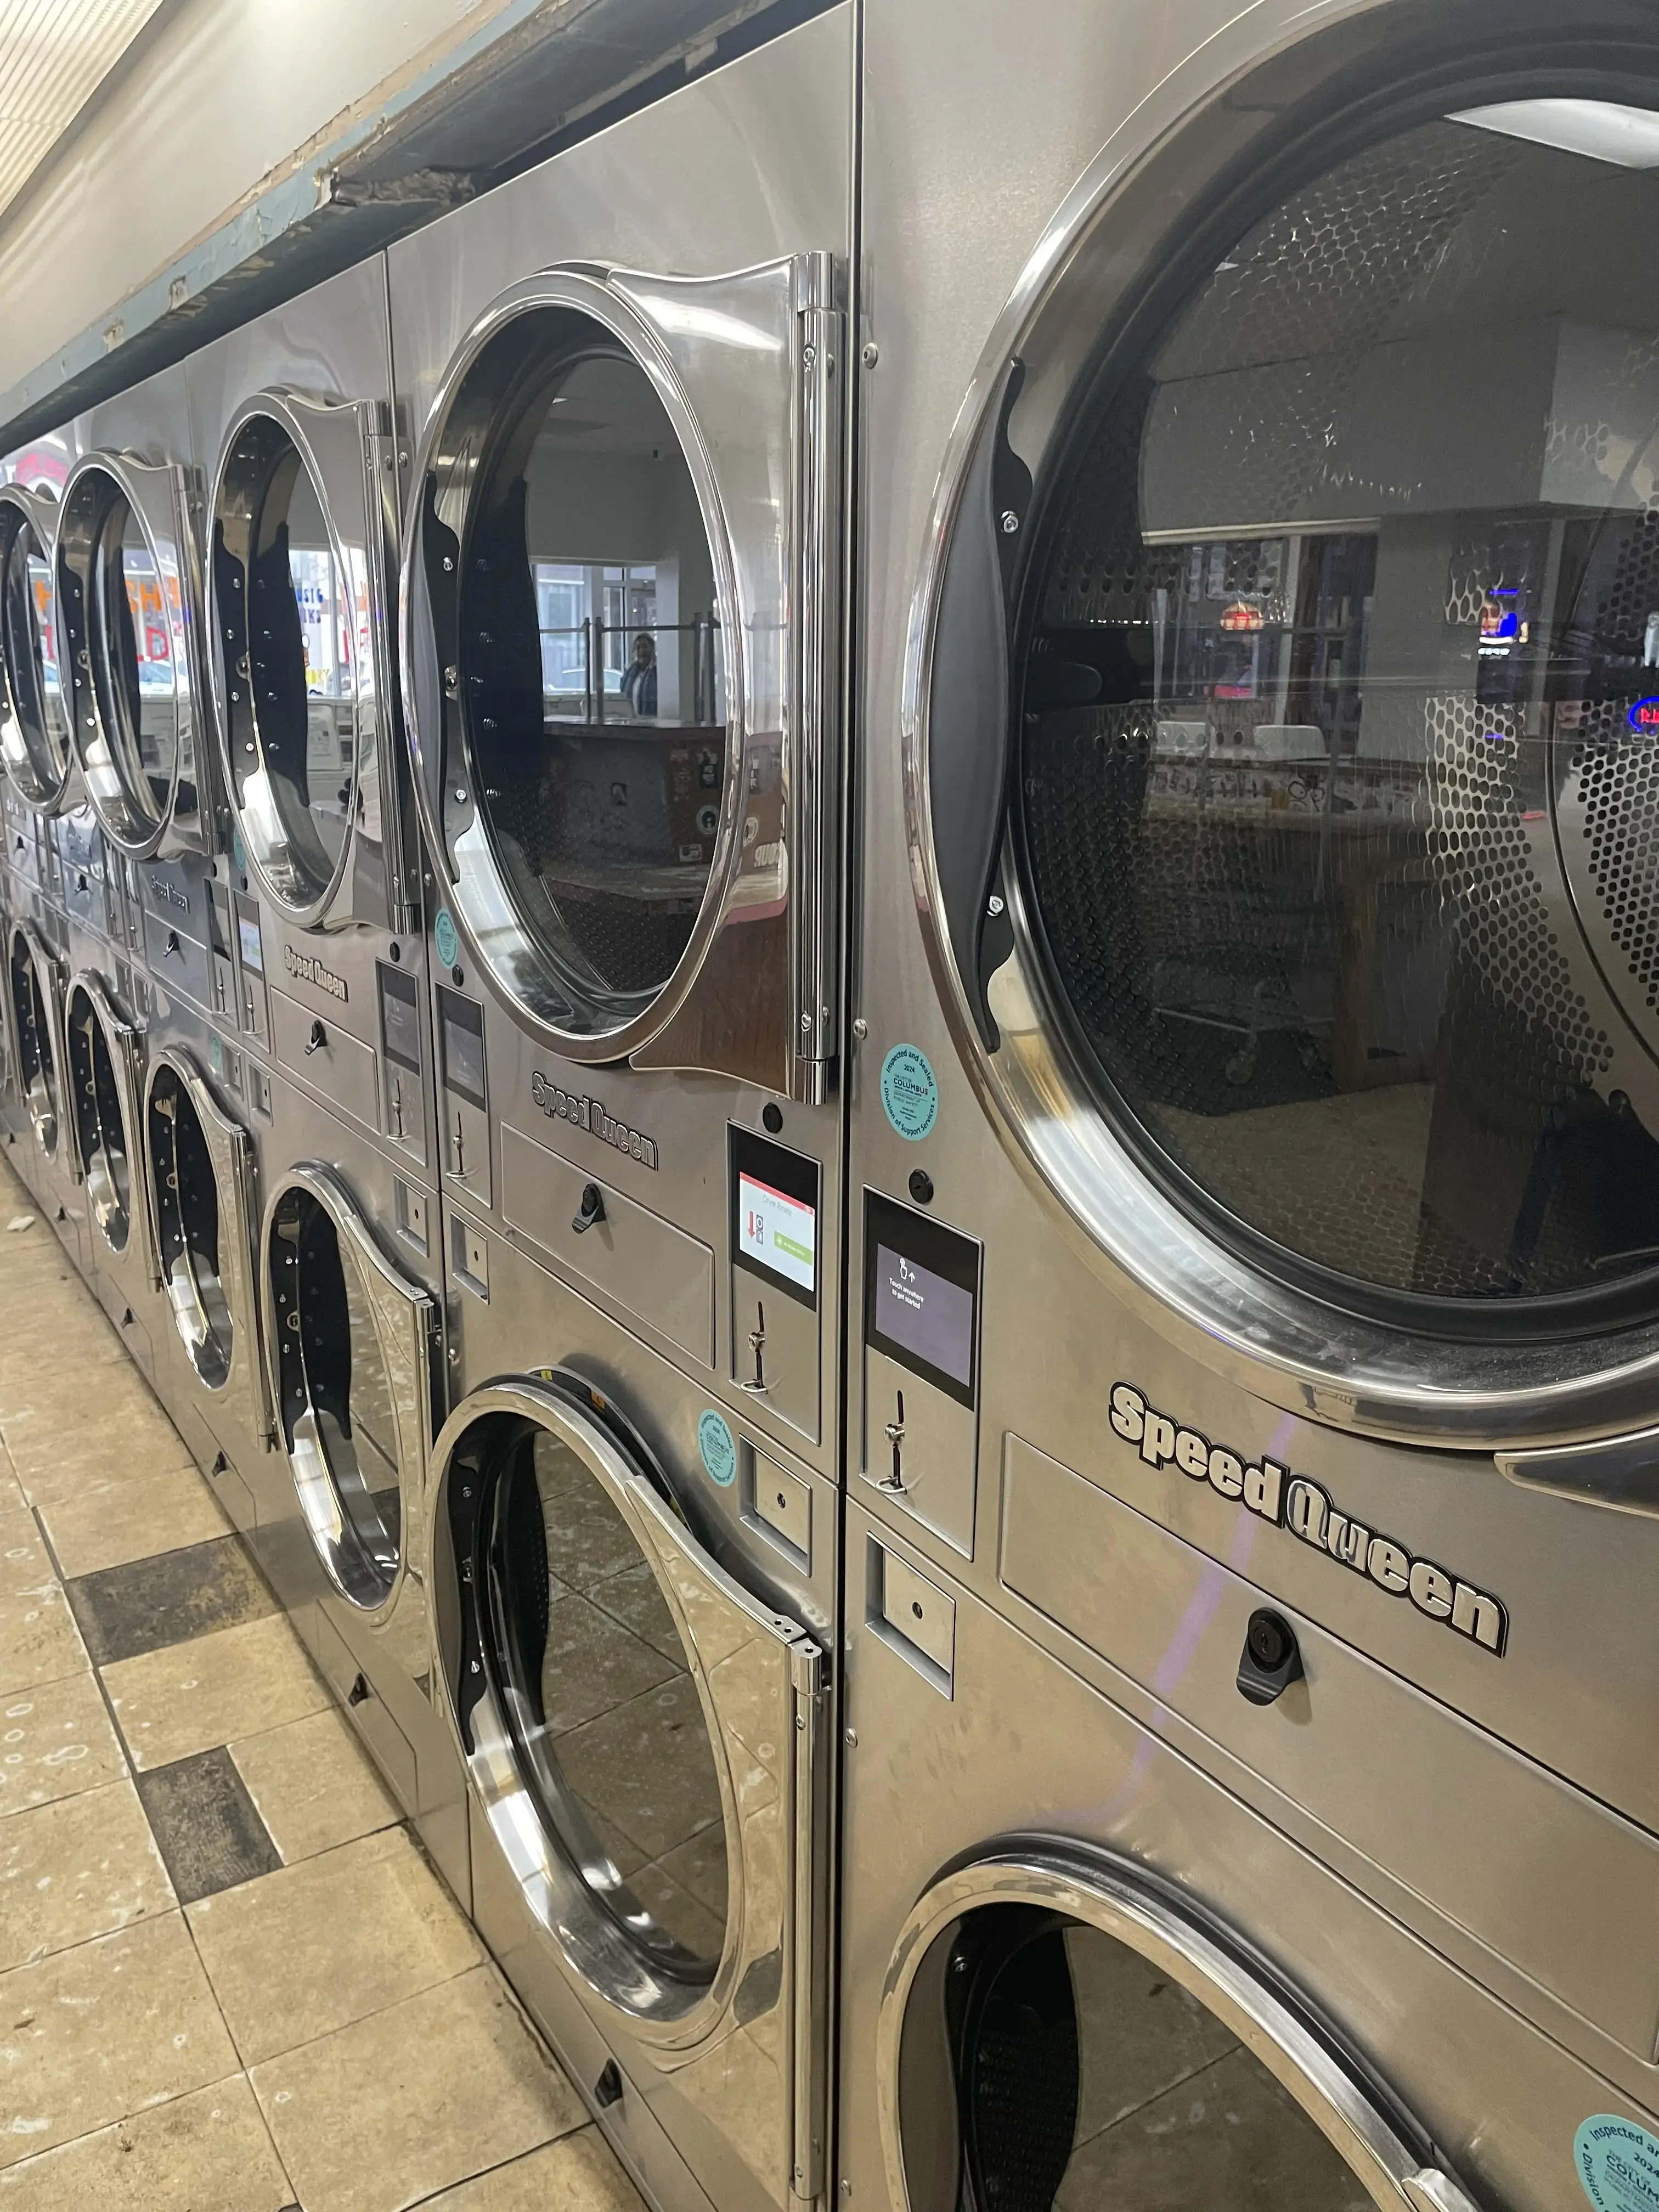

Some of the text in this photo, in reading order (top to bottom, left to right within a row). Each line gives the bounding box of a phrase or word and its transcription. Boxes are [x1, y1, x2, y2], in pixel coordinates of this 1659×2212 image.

[285, 945, 348, 1003] Speed Queen
[886, 1049, 934, 1087] Inspected and Sealed
[893, 1077, 928, 1095] COLUMBUS
[904, 1064, 915, 1074] 2024
[532, 1071, 658, 1172] Speed Queen
[884, 1088, 895, 1119] Division
[895, 1119, 901, 1127] of
[901, 1125, 922, 1136] Support
[921, 1104, 934, 1131] Services
[763, 1195, 792, 1217] Dryer Ready
[889, 1277, 924, 1302] Touch anywhere
[905, 1296, 921, 1310] started
[1108, 1381, 1509, 1658] Speed Queen
[1589, 2126, 1644, 2146] Inspected
[1583, 2152, 1604, 2205] Division
[1606, 2155, 1659, 2203] COLUM
